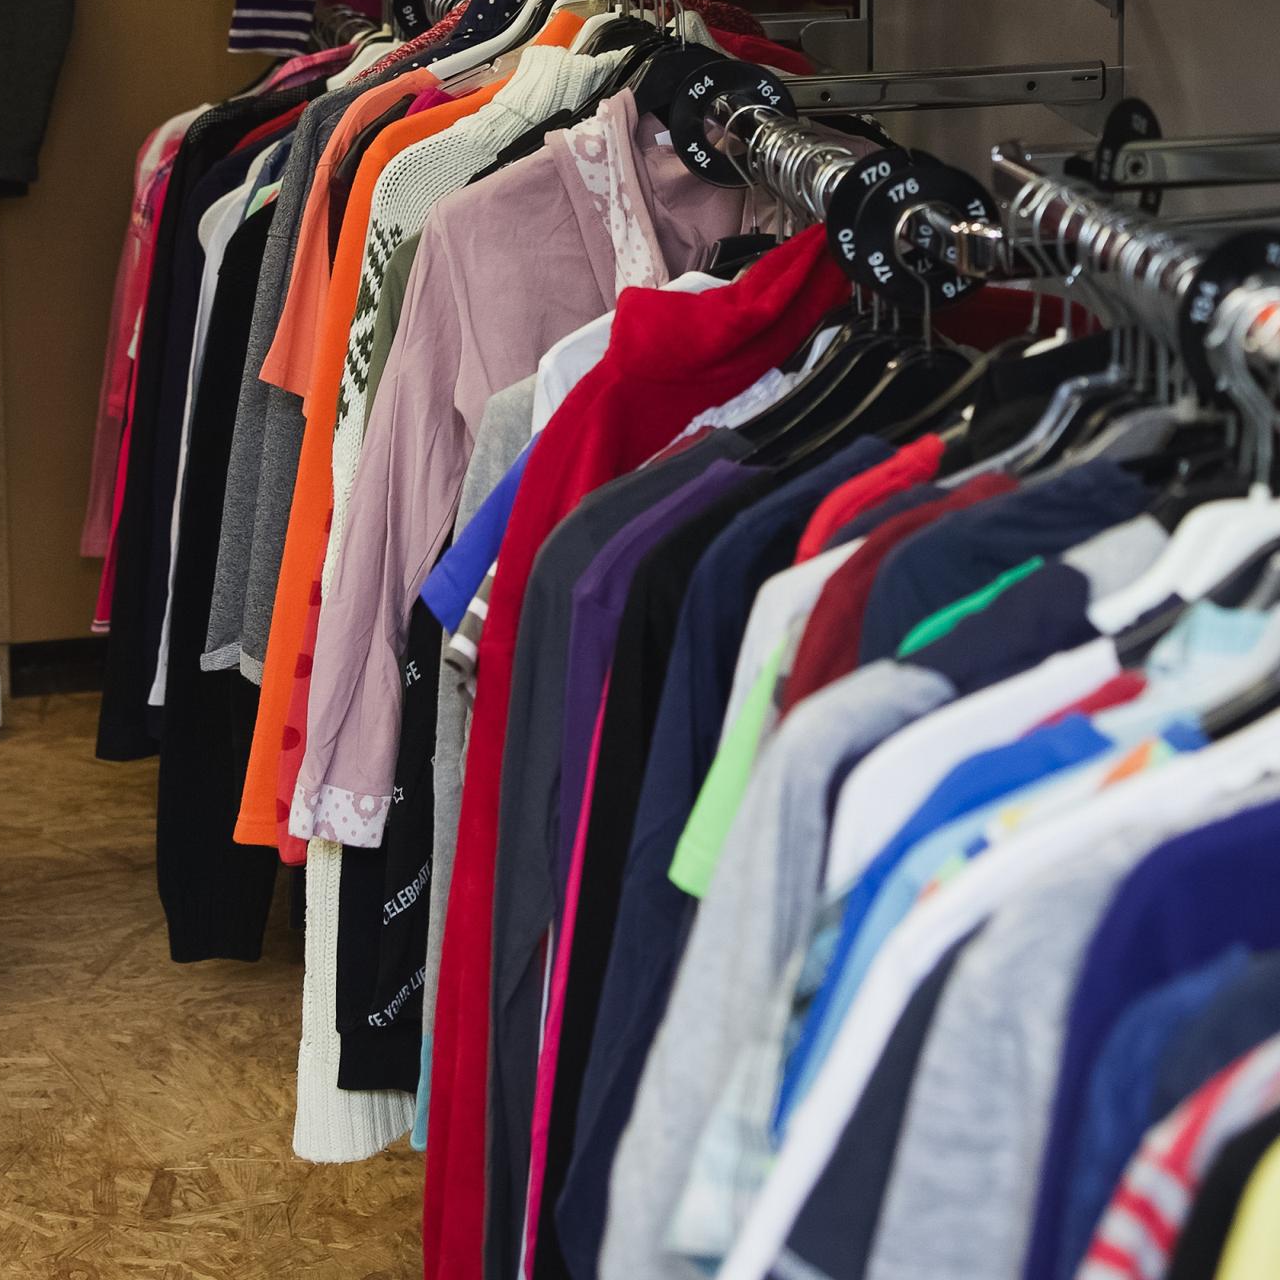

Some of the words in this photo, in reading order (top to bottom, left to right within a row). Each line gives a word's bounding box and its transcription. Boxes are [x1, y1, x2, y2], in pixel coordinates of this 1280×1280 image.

[402, 5, 418, 26] 146
[688, 75, 715, 99] 164
[756, 80, 781, 105] 164
[687, 142, 712, 168] 164
[860, 161, 892, 186] 170
[887, 177, 919, 203] 176
[838, 228, 856, 261] 170
[867, 251, 893, 284] 176
